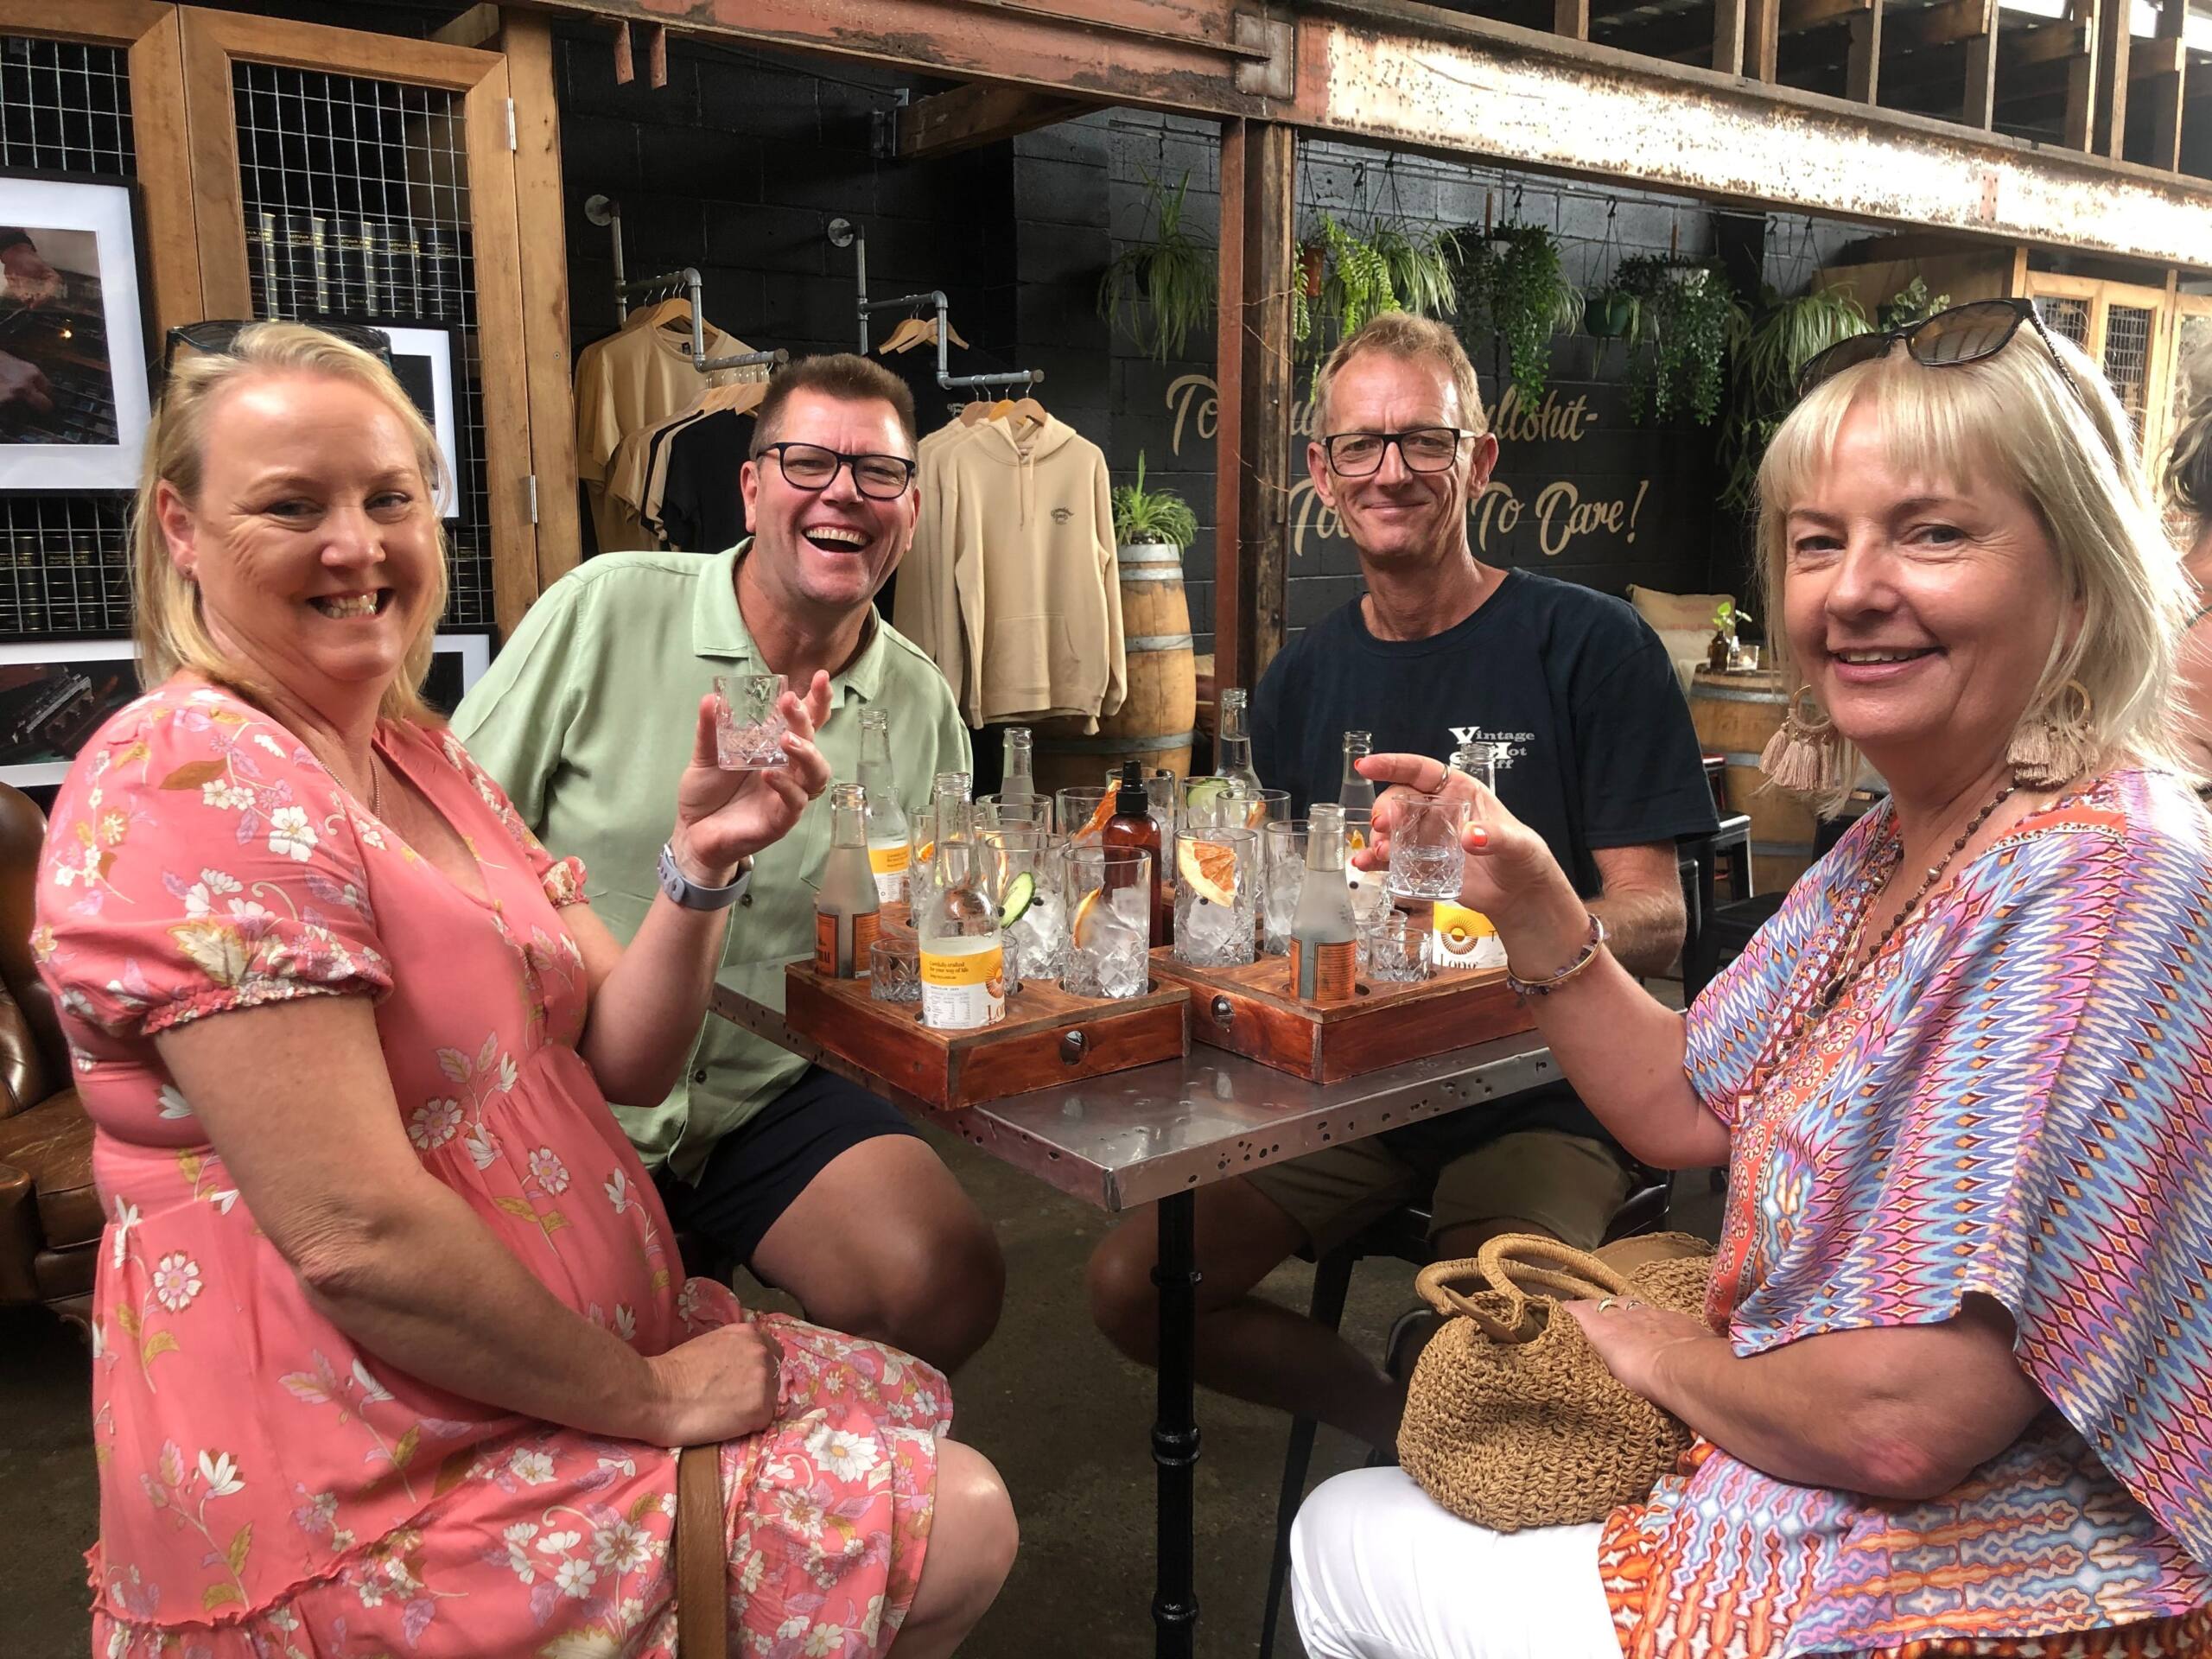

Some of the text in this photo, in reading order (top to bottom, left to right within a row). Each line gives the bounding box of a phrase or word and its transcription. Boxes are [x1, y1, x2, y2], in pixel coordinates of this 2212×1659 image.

[1166, 374, 1218, 456] To
[1484, 385, 1599, 442] llshit-
[1471, 481, 1525, 552] To
[1535, 480, 1649, 556] Care!
[1447, 726, 1535, 744] Vintage
[1475, 741, 1528, 760] Hot
[1449, 751, 1514, 770] Sff
